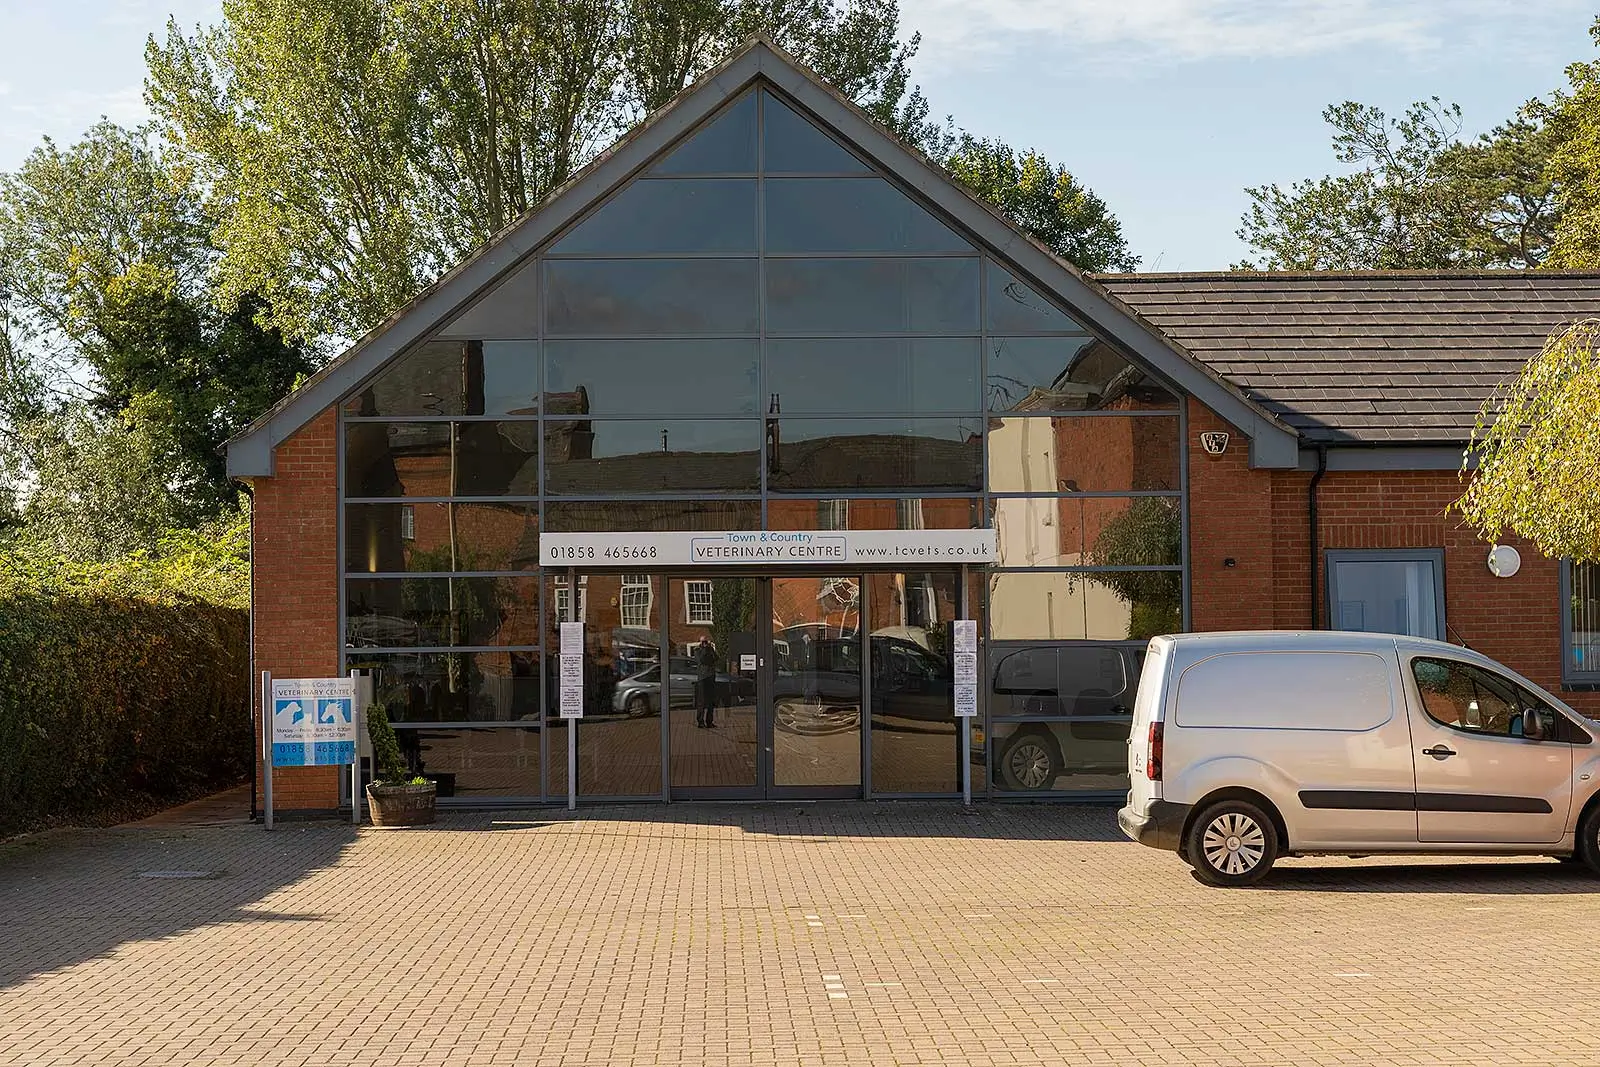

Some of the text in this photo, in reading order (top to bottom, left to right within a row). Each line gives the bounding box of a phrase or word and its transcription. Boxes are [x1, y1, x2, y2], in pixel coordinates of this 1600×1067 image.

[727, 533, 813, 544] Town & Country
[550, 546, 658, 559] 01858 465668
[696, 546, 841, 557] VETERINARY CENTRE
[855, 543, 988, 556] www.tcvets.co.uk
[278, 688, 324, 696] VETERINARY
[280, 743, 350, 753] 01858 465668
